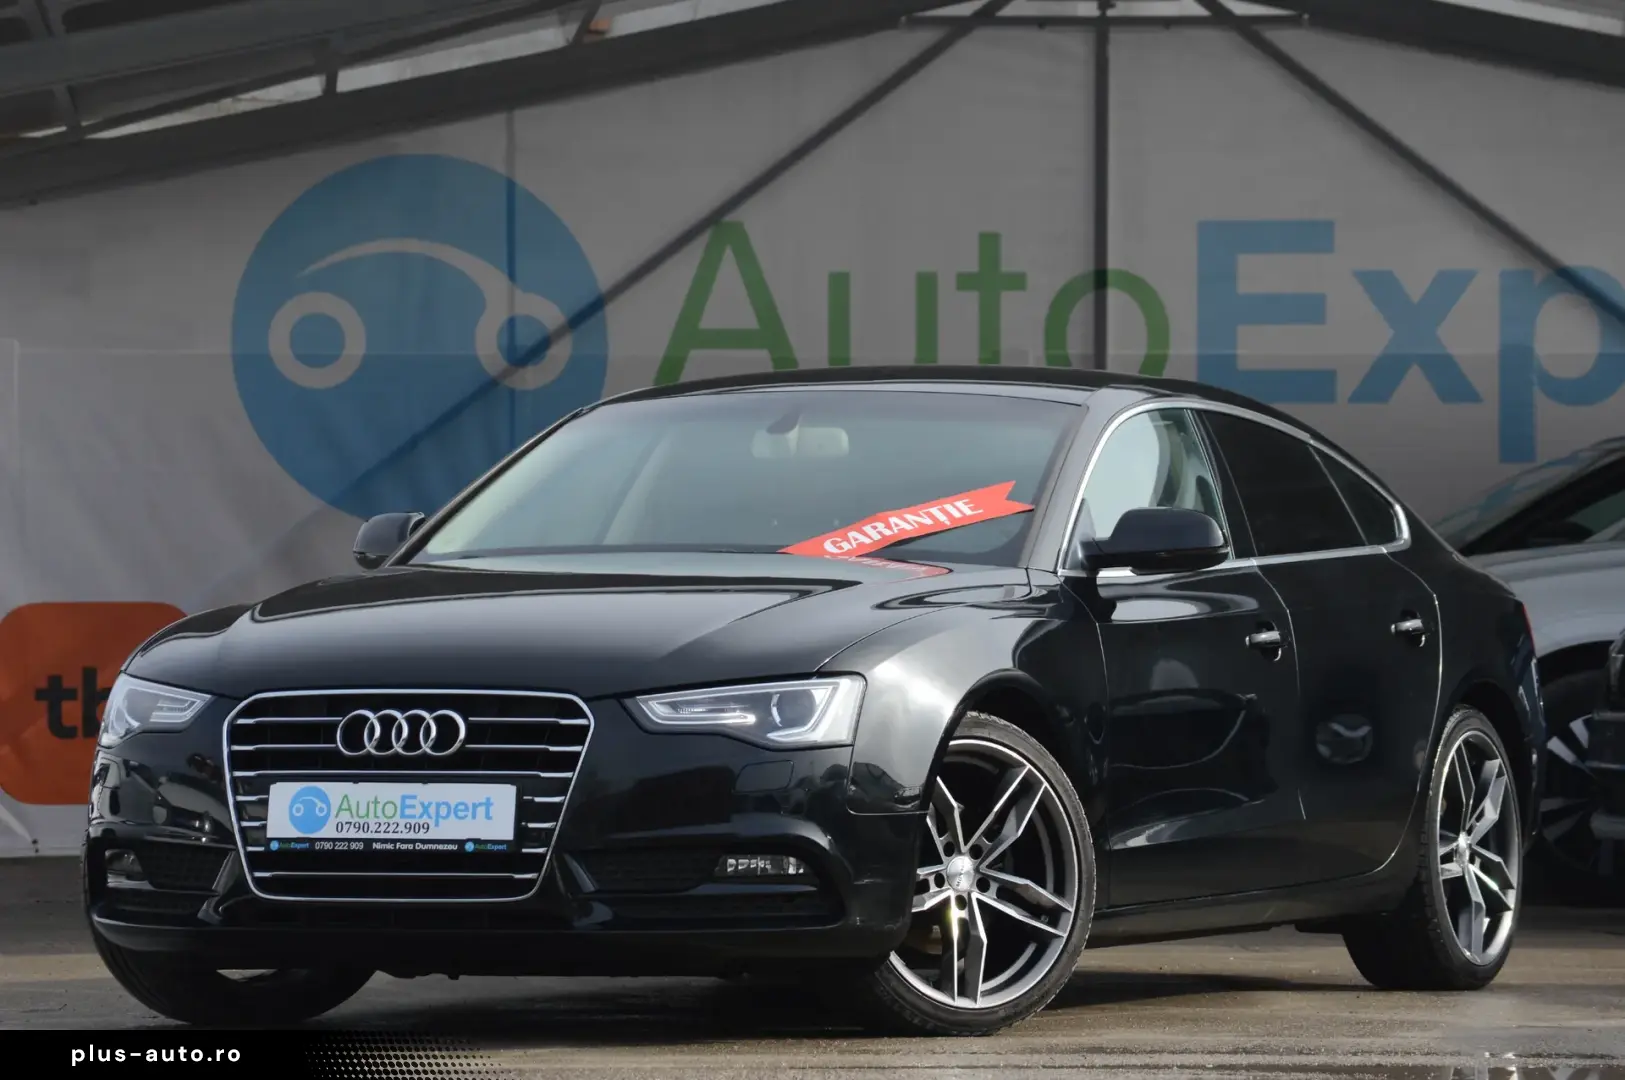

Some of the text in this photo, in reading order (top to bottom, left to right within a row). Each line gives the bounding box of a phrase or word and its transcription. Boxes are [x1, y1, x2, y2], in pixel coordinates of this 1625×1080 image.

[822, 498, 984, 554] GARANȚIE
[334, 794, 494, 828] AutoExpert
[335, 821, 430, 834] 0790.222.909
[315, 842, 334, 850] 0790
[334, 842, 349, 850] 222
[349, 842, 364, 850] 909
[372, 842, 395, 850] Nimic
[396, 842, 414, 850] Fara
